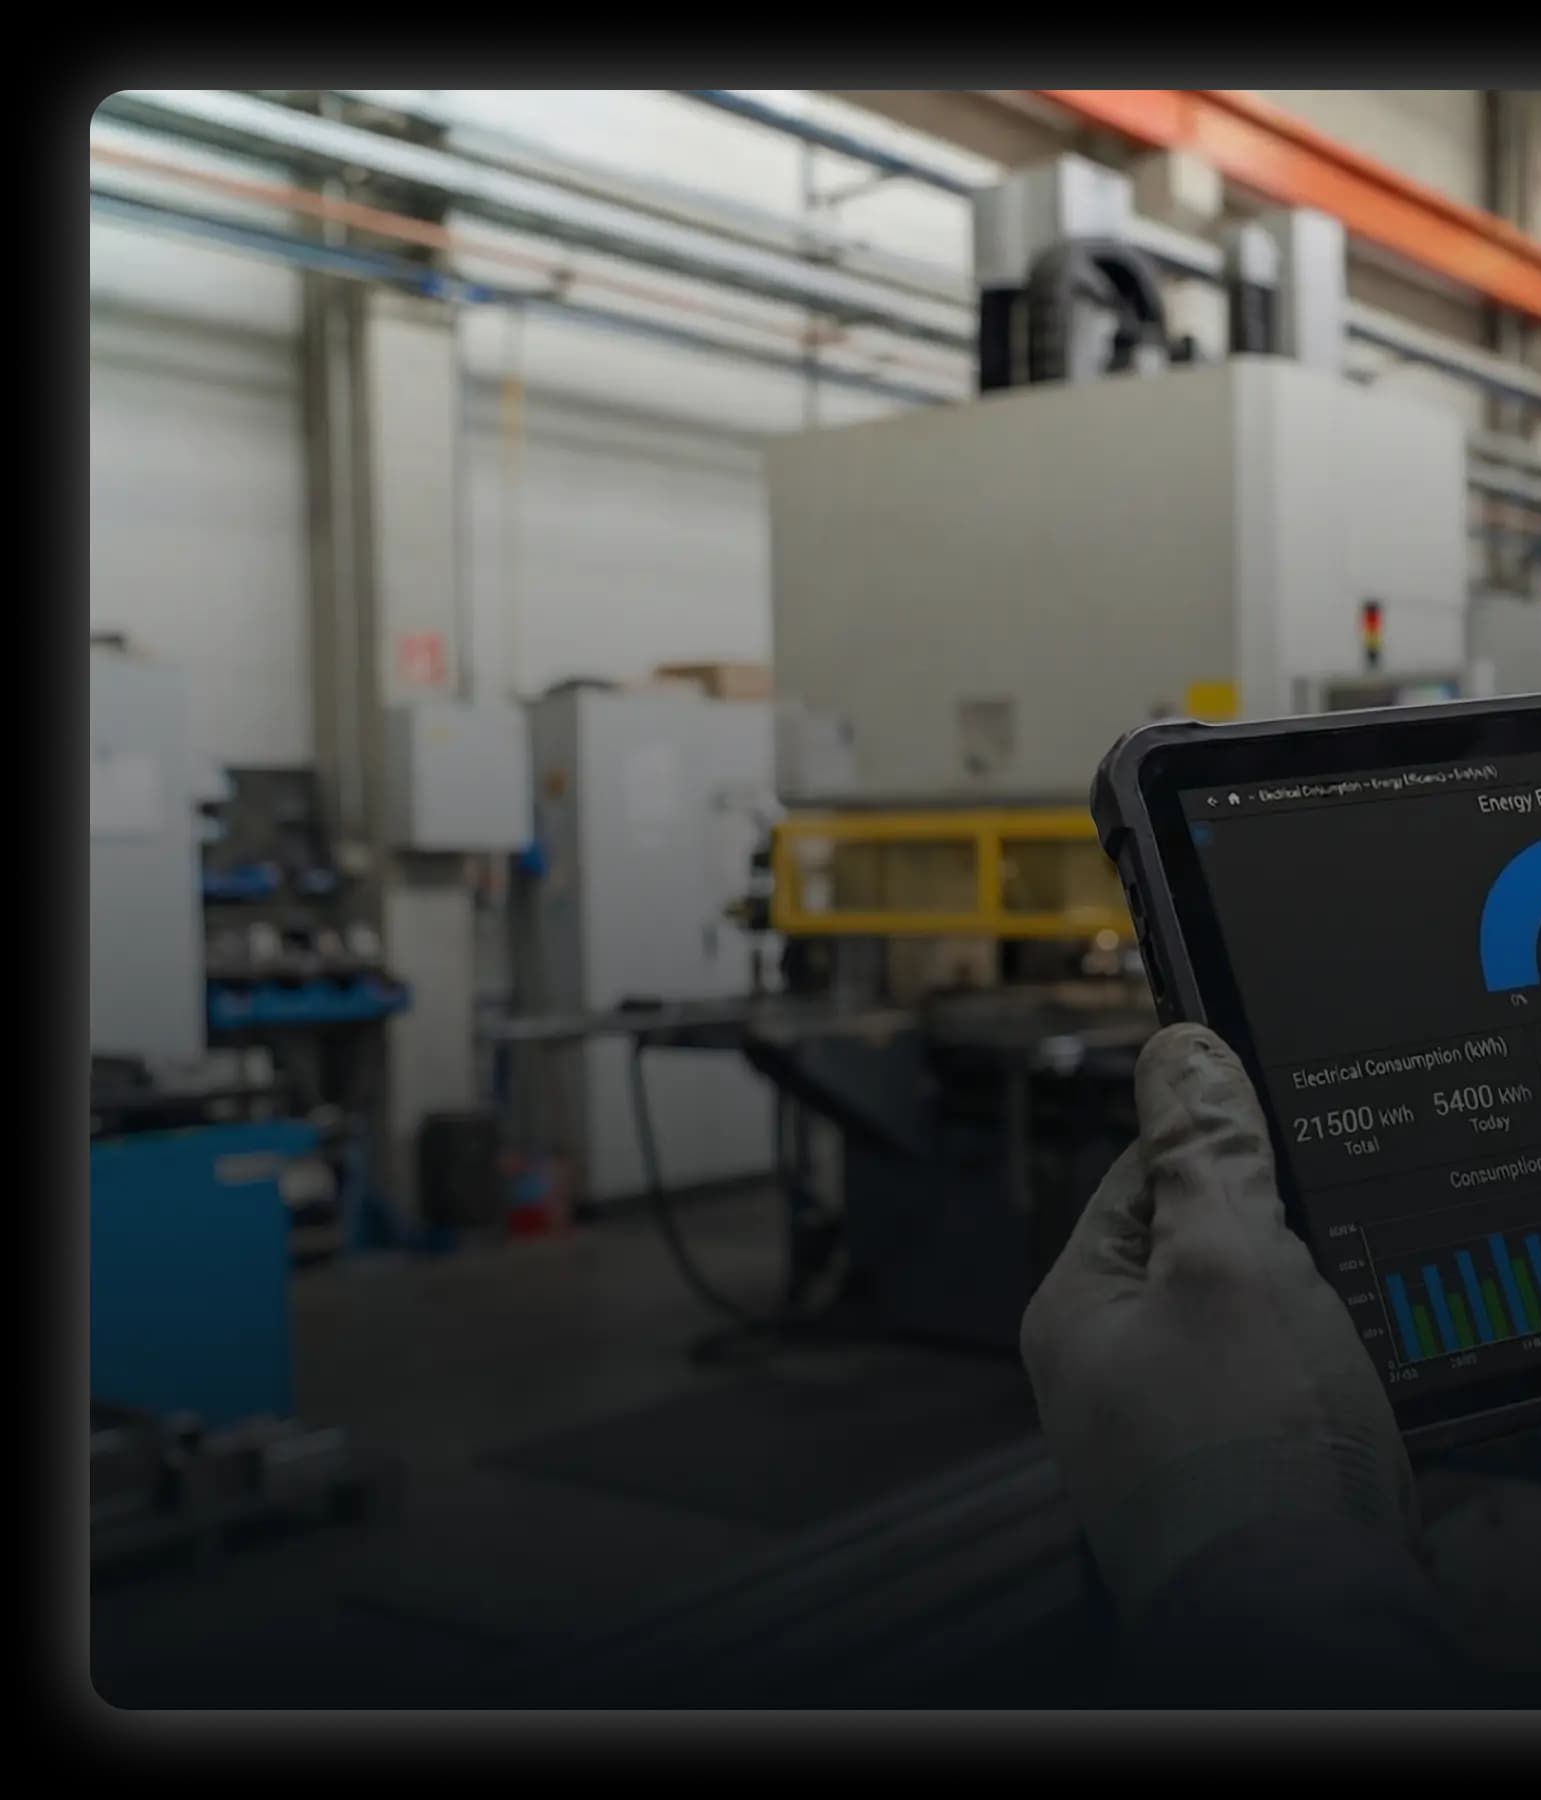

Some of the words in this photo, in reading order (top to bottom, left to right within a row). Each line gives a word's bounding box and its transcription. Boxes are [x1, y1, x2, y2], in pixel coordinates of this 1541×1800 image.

[1478, 792, 1532, 813] Energy
[1292, 1060, 1362, 1090] Electrical
[1365, 1046, 1461, 1077] Consumption
[1464, 1036, 1509, 1063] (kWh)
[1432, 1084, 1493, 1116] 5400
[1498, 1084, 1532, 1105] kWh
[1293, 1105, 1375, 1143] 21500
[1378, 1104, 1414, 1128] kWh
[1469, 1115, 1511, 1134] Today
[1344, 1136, 1380, 1156] Total
